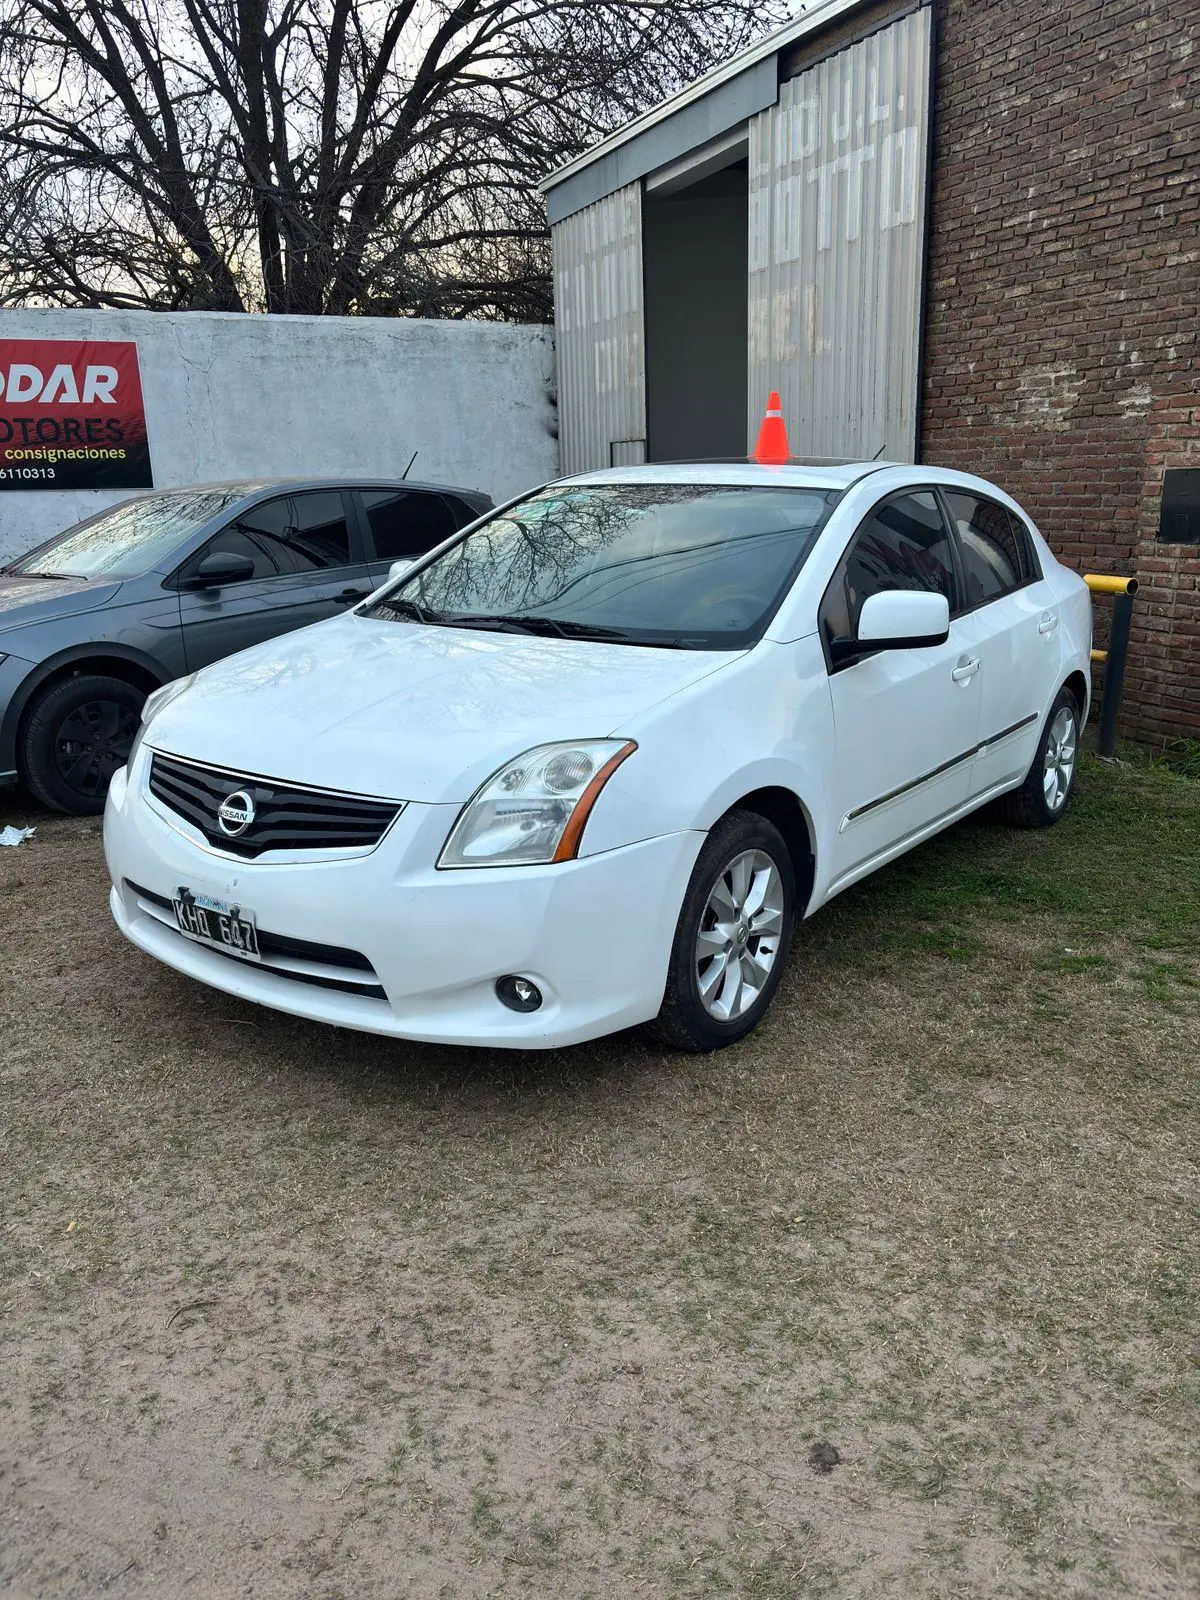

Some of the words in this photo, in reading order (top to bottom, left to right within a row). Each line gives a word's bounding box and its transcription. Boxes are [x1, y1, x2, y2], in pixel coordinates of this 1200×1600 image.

[0, 364, 118, 404] DAR
[5, 446, 126, 463] consignaciones
[0, 468, 56, 479] 6110313
[220, 809, 248, 821] NISSAN
